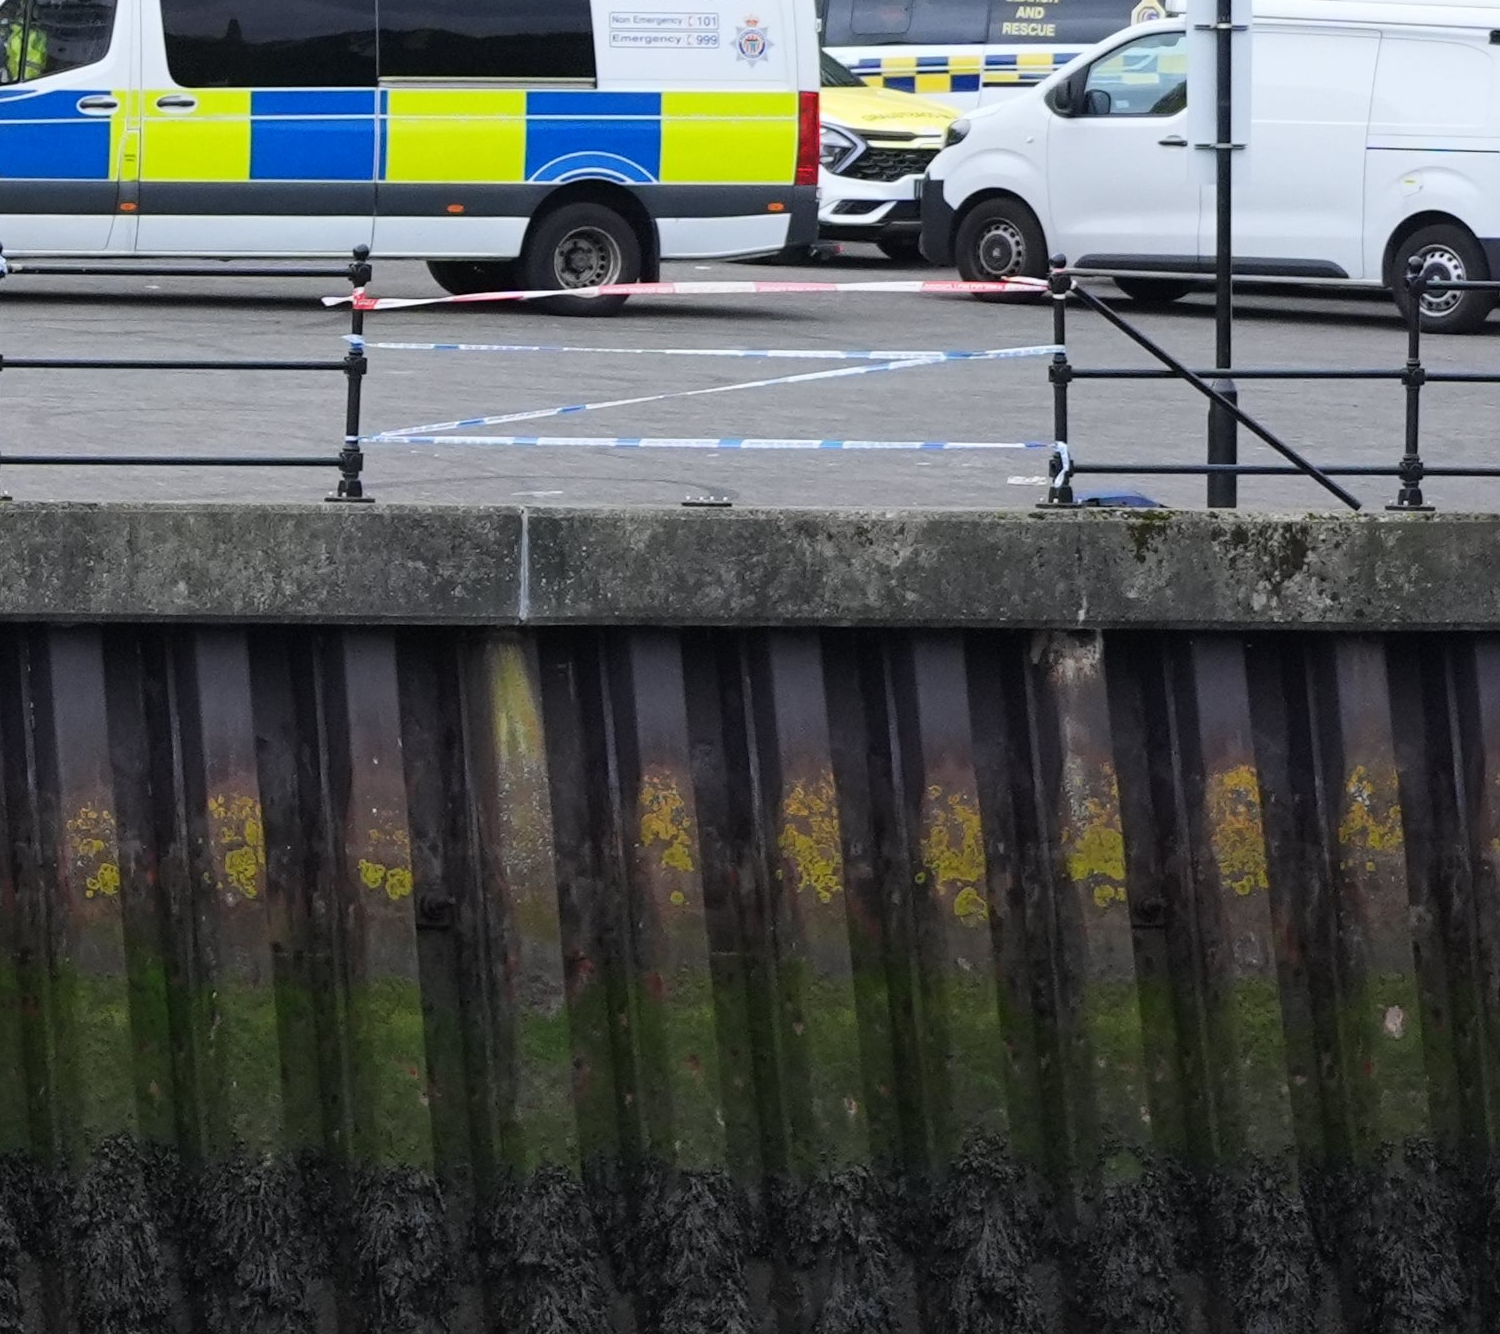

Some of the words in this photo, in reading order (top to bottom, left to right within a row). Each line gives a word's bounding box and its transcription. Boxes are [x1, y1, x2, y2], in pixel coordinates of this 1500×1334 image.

[1015, 7, 1045, 19] AND
[633, 15, 682, 26] Emergency
[698, 16, 717, 27] 101
[1002, 22, 1056, 37] RESCUE
[612, 34, 682, 45] Emergency
[696, 34, 718, 46] 999
